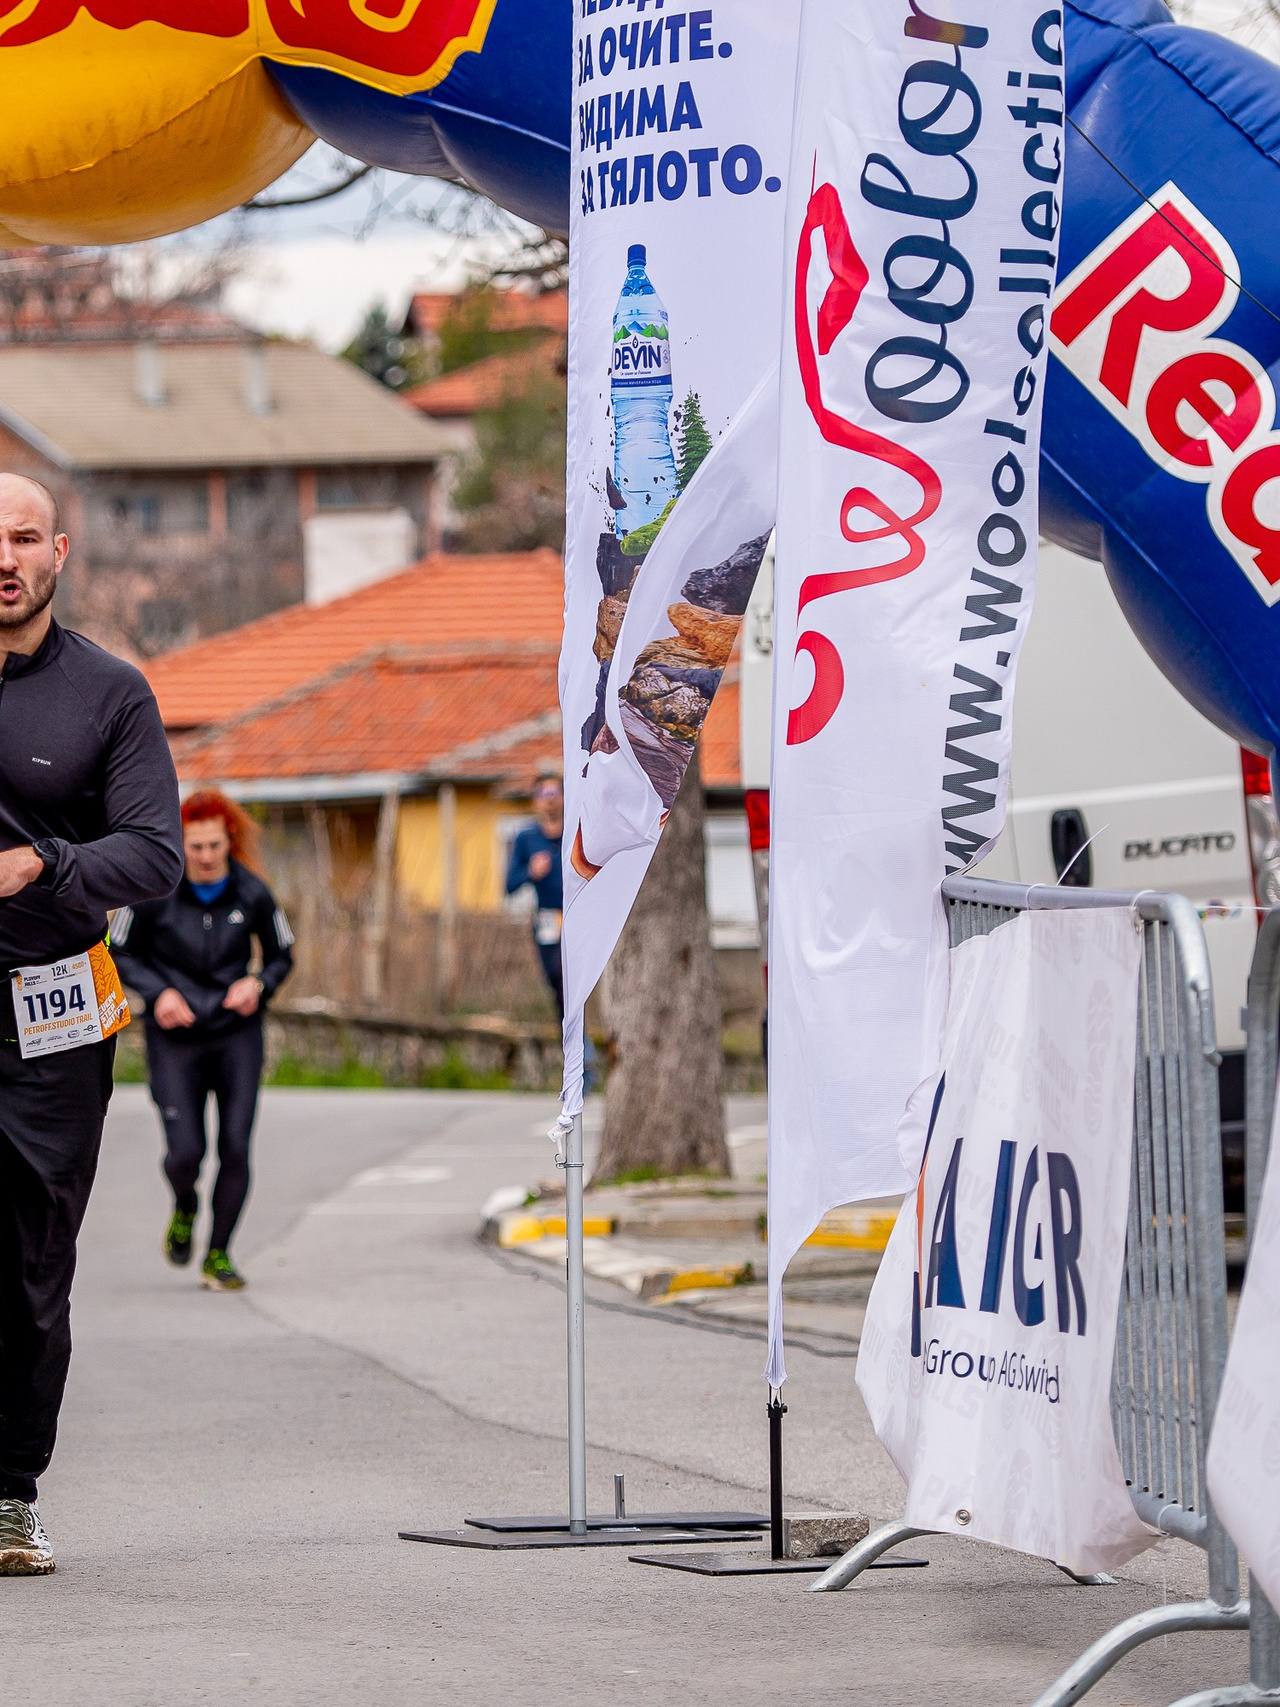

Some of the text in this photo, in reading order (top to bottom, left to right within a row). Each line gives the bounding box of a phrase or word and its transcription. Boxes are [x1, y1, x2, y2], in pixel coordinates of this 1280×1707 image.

[579, 9, 733, 87] ЗА ОЧИТЕ.
[579, 81, 703, 153] ВИДИМА
[581, 144, 782, 217] ЗА ТЯЛОТО.
[614, 344, 662, 370] DEVIN
[1124, 832, 1236, 861] DUCATO
[51, 964, 68, 977] 12K
[23, 984, 86, 1022] 1194
[76, 1013, 93, 1024] TRAIL
[997, 1350, 1018, 1387] AG
